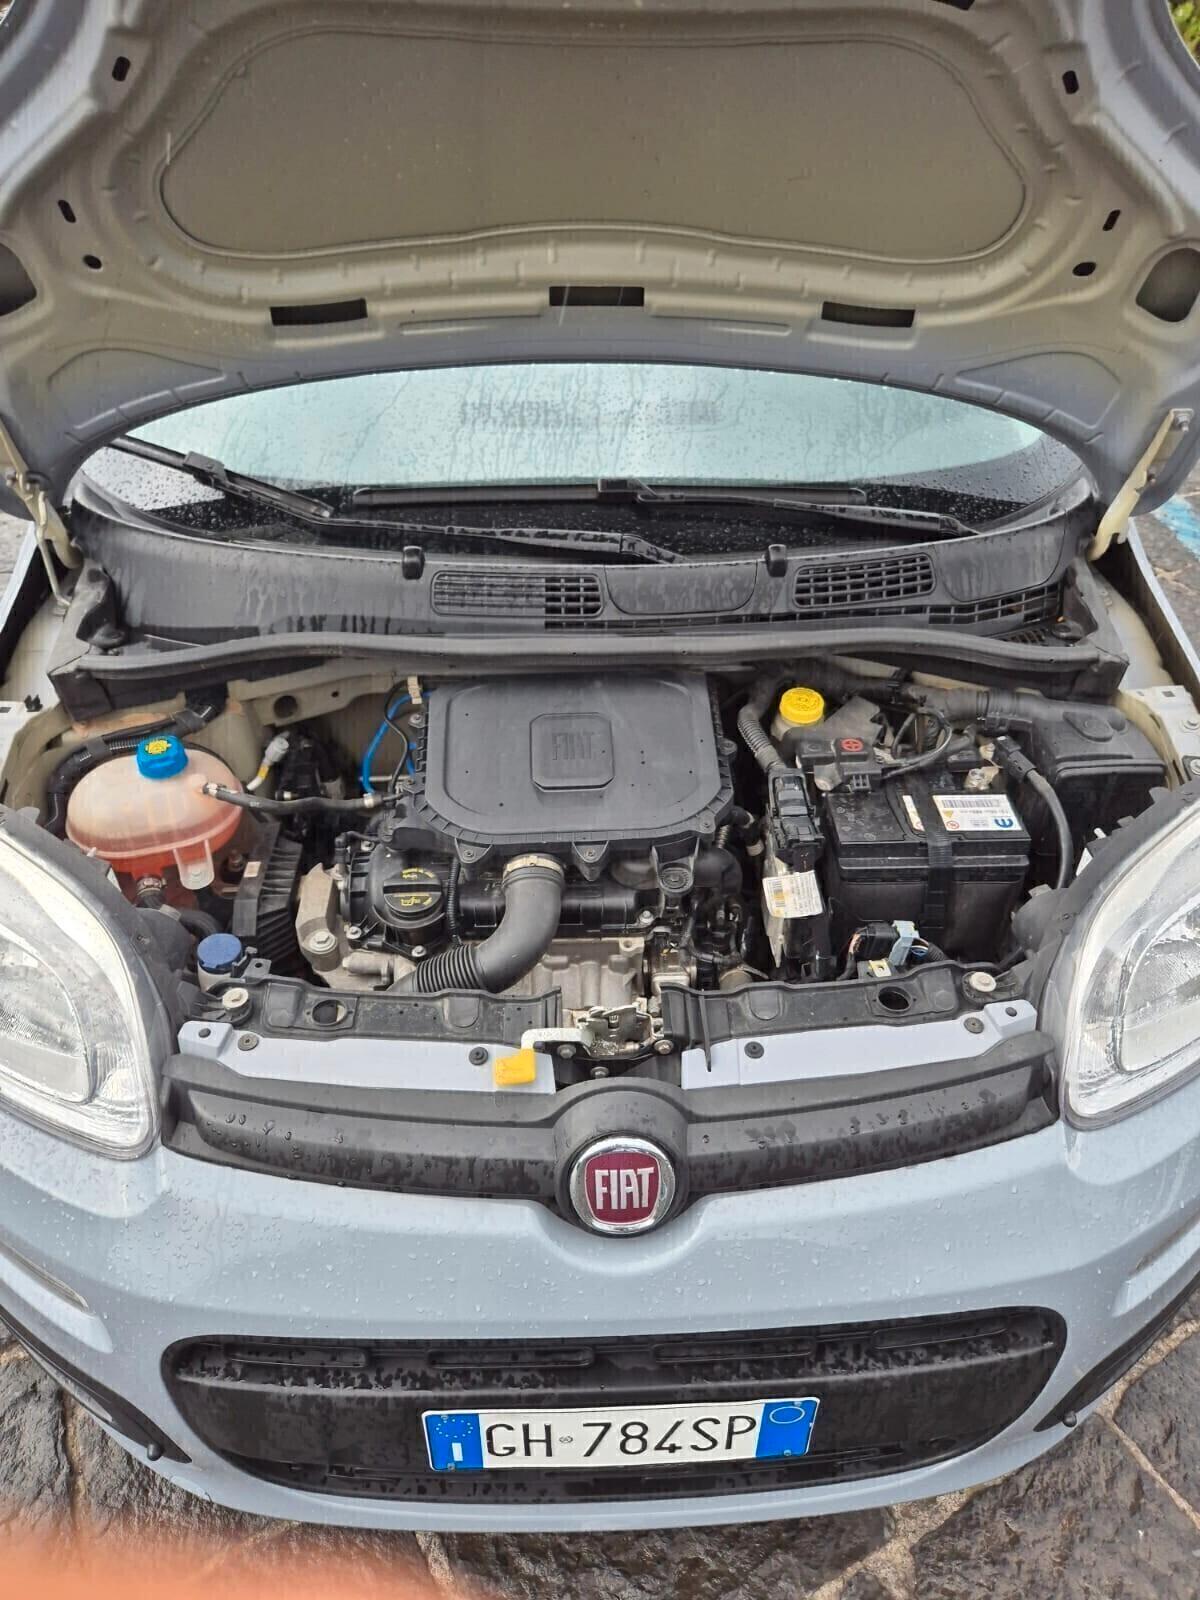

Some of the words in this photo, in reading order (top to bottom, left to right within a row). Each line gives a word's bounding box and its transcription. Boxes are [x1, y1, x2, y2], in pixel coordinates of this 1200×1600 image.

[551, 731, 595, 760] FIAT
[594, 1167, 655, 1210] FIAT
[486, 1423, 552, 1457] GH
[582, 1415, 756, 1457] 784SP
